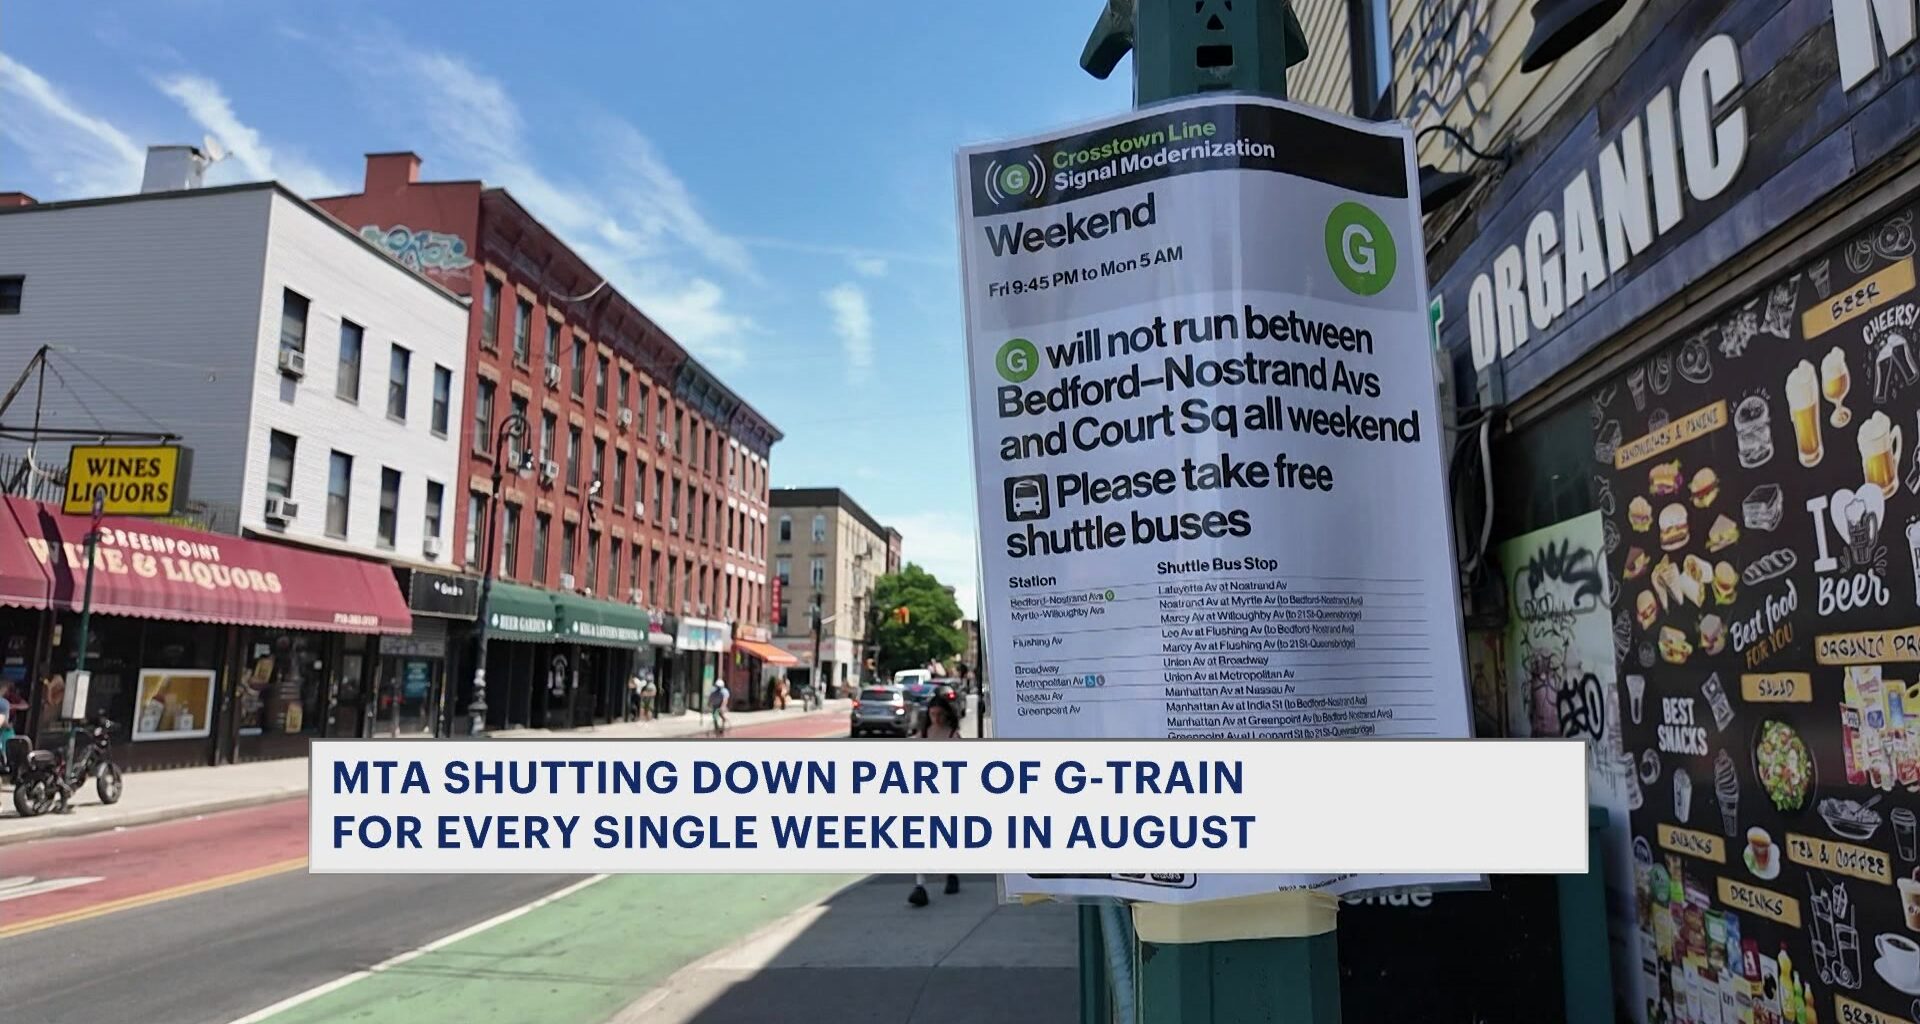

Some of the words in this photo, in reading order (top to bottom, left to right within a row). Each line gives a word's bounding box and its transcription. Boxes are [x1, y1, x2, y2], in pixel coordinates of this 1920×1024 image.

[1052, 127, 1164, 169] Crosstown
[1168, 121, 1217, 142] Line
[1054, 162, 1117, 191] Signal
[1120, 138, 1276, 173] Modernization
[1468, 33, 1749, 373] ORGANIC
[985, 193, 1156, 257] Weekend
[1342, 224, 1377, 276] G
[989, 281, 1010, 298] Fri
[1013, 275, 1050, 295] 9:45
[1052, 268, 1079, 288] PM
[1081, 266, 1098, 282] to
[1101, 258, 1137, 279] Mon
[1139, 254, 1151, 268] 5
[1153, 246, 1183, 264] AM
[1831, 281, 1880, 321] BEER
[1046, 329, 1101, 369] will
[1108, 317, 1168, 358] not
[1173, 314, 1239, 345] run
[1244, 305, 1373, 354] between
[1332, 361, 1381, 397] Avs
[1000, 420, 1066, 461] and
[1072, 405, 1175, 452] Court
[1180, 398, 1238, 439] Sq
[1243, 396, 1282, 431] all
[1287, 403, 1420, 443] weekend
[86, 457, 160, 479] WINES
[1057, 468, 1176, 507] Please
[1181, 453, 1270, 491] take
[1273, 454, 1333, 491] free
[71, 482, 169, 503] LIQUORS
[1006, 516, 1126, 559] shuttle
[1132, 509, 1251, 545] buses
[1806, 496, 1838, 572] I
[132, 551, 157, 578] &
[161, 556, 282, 594] LIQUORS
[1157, 559, 1210, 575] Shuttle
[1212, 557, 1242, 571] Bus
[1244, 556, 1278, 572] Stop
[1008, 576, 1057, 589] Station
[1205, 582, 1218, 592] Av
[1219, 582, 1228, 591] at
[1275, 580, 1287, 590] Av
[1818, 568, 1889, 616] Beer
[1159, 598, 1204, 609] Nostrand
[1205, 597, 1219, 606] Av
[1220, 596, 1229, 606] at
[1231, 595, 1263, 607] Myrtle
[1264, 595, 1276, 605] Av
[1277, 595, 1289, 606] (to
[1160, 613, 1190, 624] Marcy
[1192, 612, 1205, 621] Av
[1206, 611, 1216, 620] at
[1217, 610, 1272, 622] Willoughby
[1273, 610, 1285, 619] Av
[1730, 609, 1763, 652] Best
[1765, 578, 1797, 634] food
[1013, 637, 1050, 648] Flushing
[1052, 636, 1063, 646] Av
[1181, 628, 1193, 637] Av
[1194, 627, 1204, 636] at
[1206, 625, 1249, 637] Flushing
[1250, 625, 1263, 635] Av
[1264, 625, 1277, 636] (to
[1768, 621, 1793, 653] YOU
[1162, 643, 1192, 654] Marcy
[1194, 642, 1207, 651] Av
[1208, 641, 1218, 651] at
[1220, 640, 1262, 652] Flushing
[1263, 639, 1275, 649] Av
[1277, 639, 1289, 650] (to
[1820, 634, 1885, 659] ORGANIC
[1014, 665, 1059, 675] Broadway
[1163, 657, 1192, 667] Union
[1192, 657, 1205, 666] Av
[1207, 656, 1217, 666] at
[1218, 655, 1269, 666] Broadway
[1016, 677, 1072, 689] Metropolitan
[1073, 676, 1084, 686] Av
[1164, 672, 1192, 682] Union
[1194, 671, 1207, 680] Av
[1208, 671, 1218, 680] at
[1220, 669, 1282, 682] Metropolitan
[1283, 669, 1295, 679] Av
[1016, 692, 1050, 702] Nassau
[1052, 691, 1063, 701] Av
[1165, 687, 1218, 697] Manhattan
[1220, 686, 1233, 696] Av
[1234, 686, 1244, 695] at
[1246, 685, 1283, 695] Nassau
[1284, 684, 1296, 693] Av
[1017, 705, 1068, 717] Greenpoint
[1069, 704, 1081, 714] Av
[1166, 701, 1219, 712] Manhattan
[1221, 701, 1234, 711] Av
[1236, 700, 1245, 711] at
[1247, 700, 1271, 711] India
[1272, 700, 1283, 710] St
[1284, 699, 1296, 710] (to
[1662, 698, 1694, 725] BEST
[1167, 717, 1221, 728] Manhattan
[1222, 716, 1236, 726] Av
[1237, 716, 1247, 725] at
[1248, 714, 1301, 726] Greenpoint
[1303, 714, 1312, 724] Av
[1658, 724, 1708, 756] SNACKS
[1819, 844, 1829, 861] &
[1731, 884, 1783, 916] DRINKS
